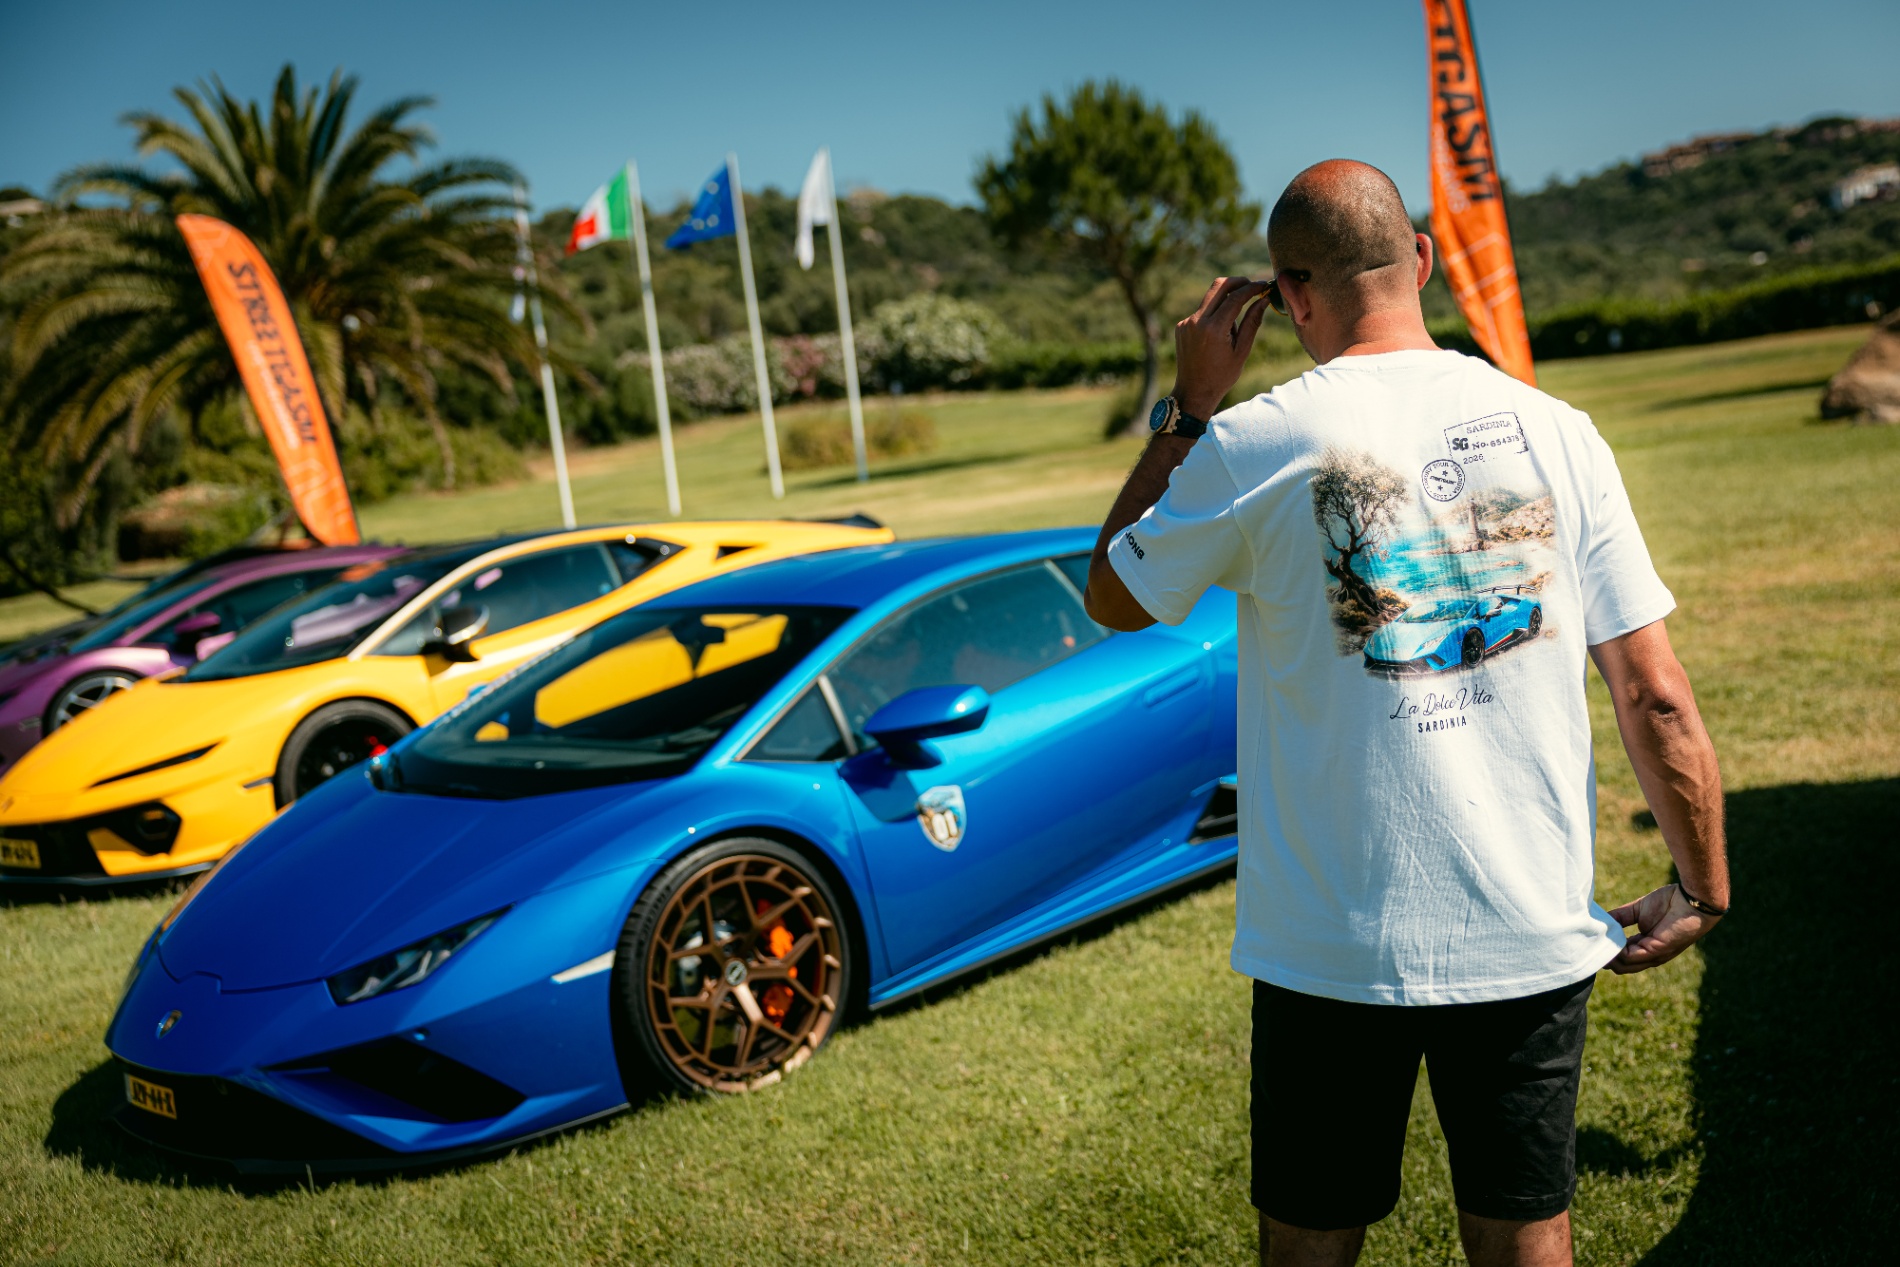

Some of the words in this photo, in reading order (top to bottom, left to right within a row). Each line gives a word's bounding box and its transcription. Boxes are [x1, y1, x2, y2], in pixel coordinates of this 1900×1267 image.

[1434, 0, 1494, 202] TGASM
[227, 260, 318, 444] STREETGASM
[1466, 421, 1512, 434] SARDINIA
[1452, 437, 1470, 451] SG
[1463, 454, 1484, 464] 2026
[1389, 696, 1420, 719] La
[1423, 692, 1457, 716] Dolce
[1456, 683, 1494, 710] Vita
[1418, 716, 1467, 733] SARDINIA
